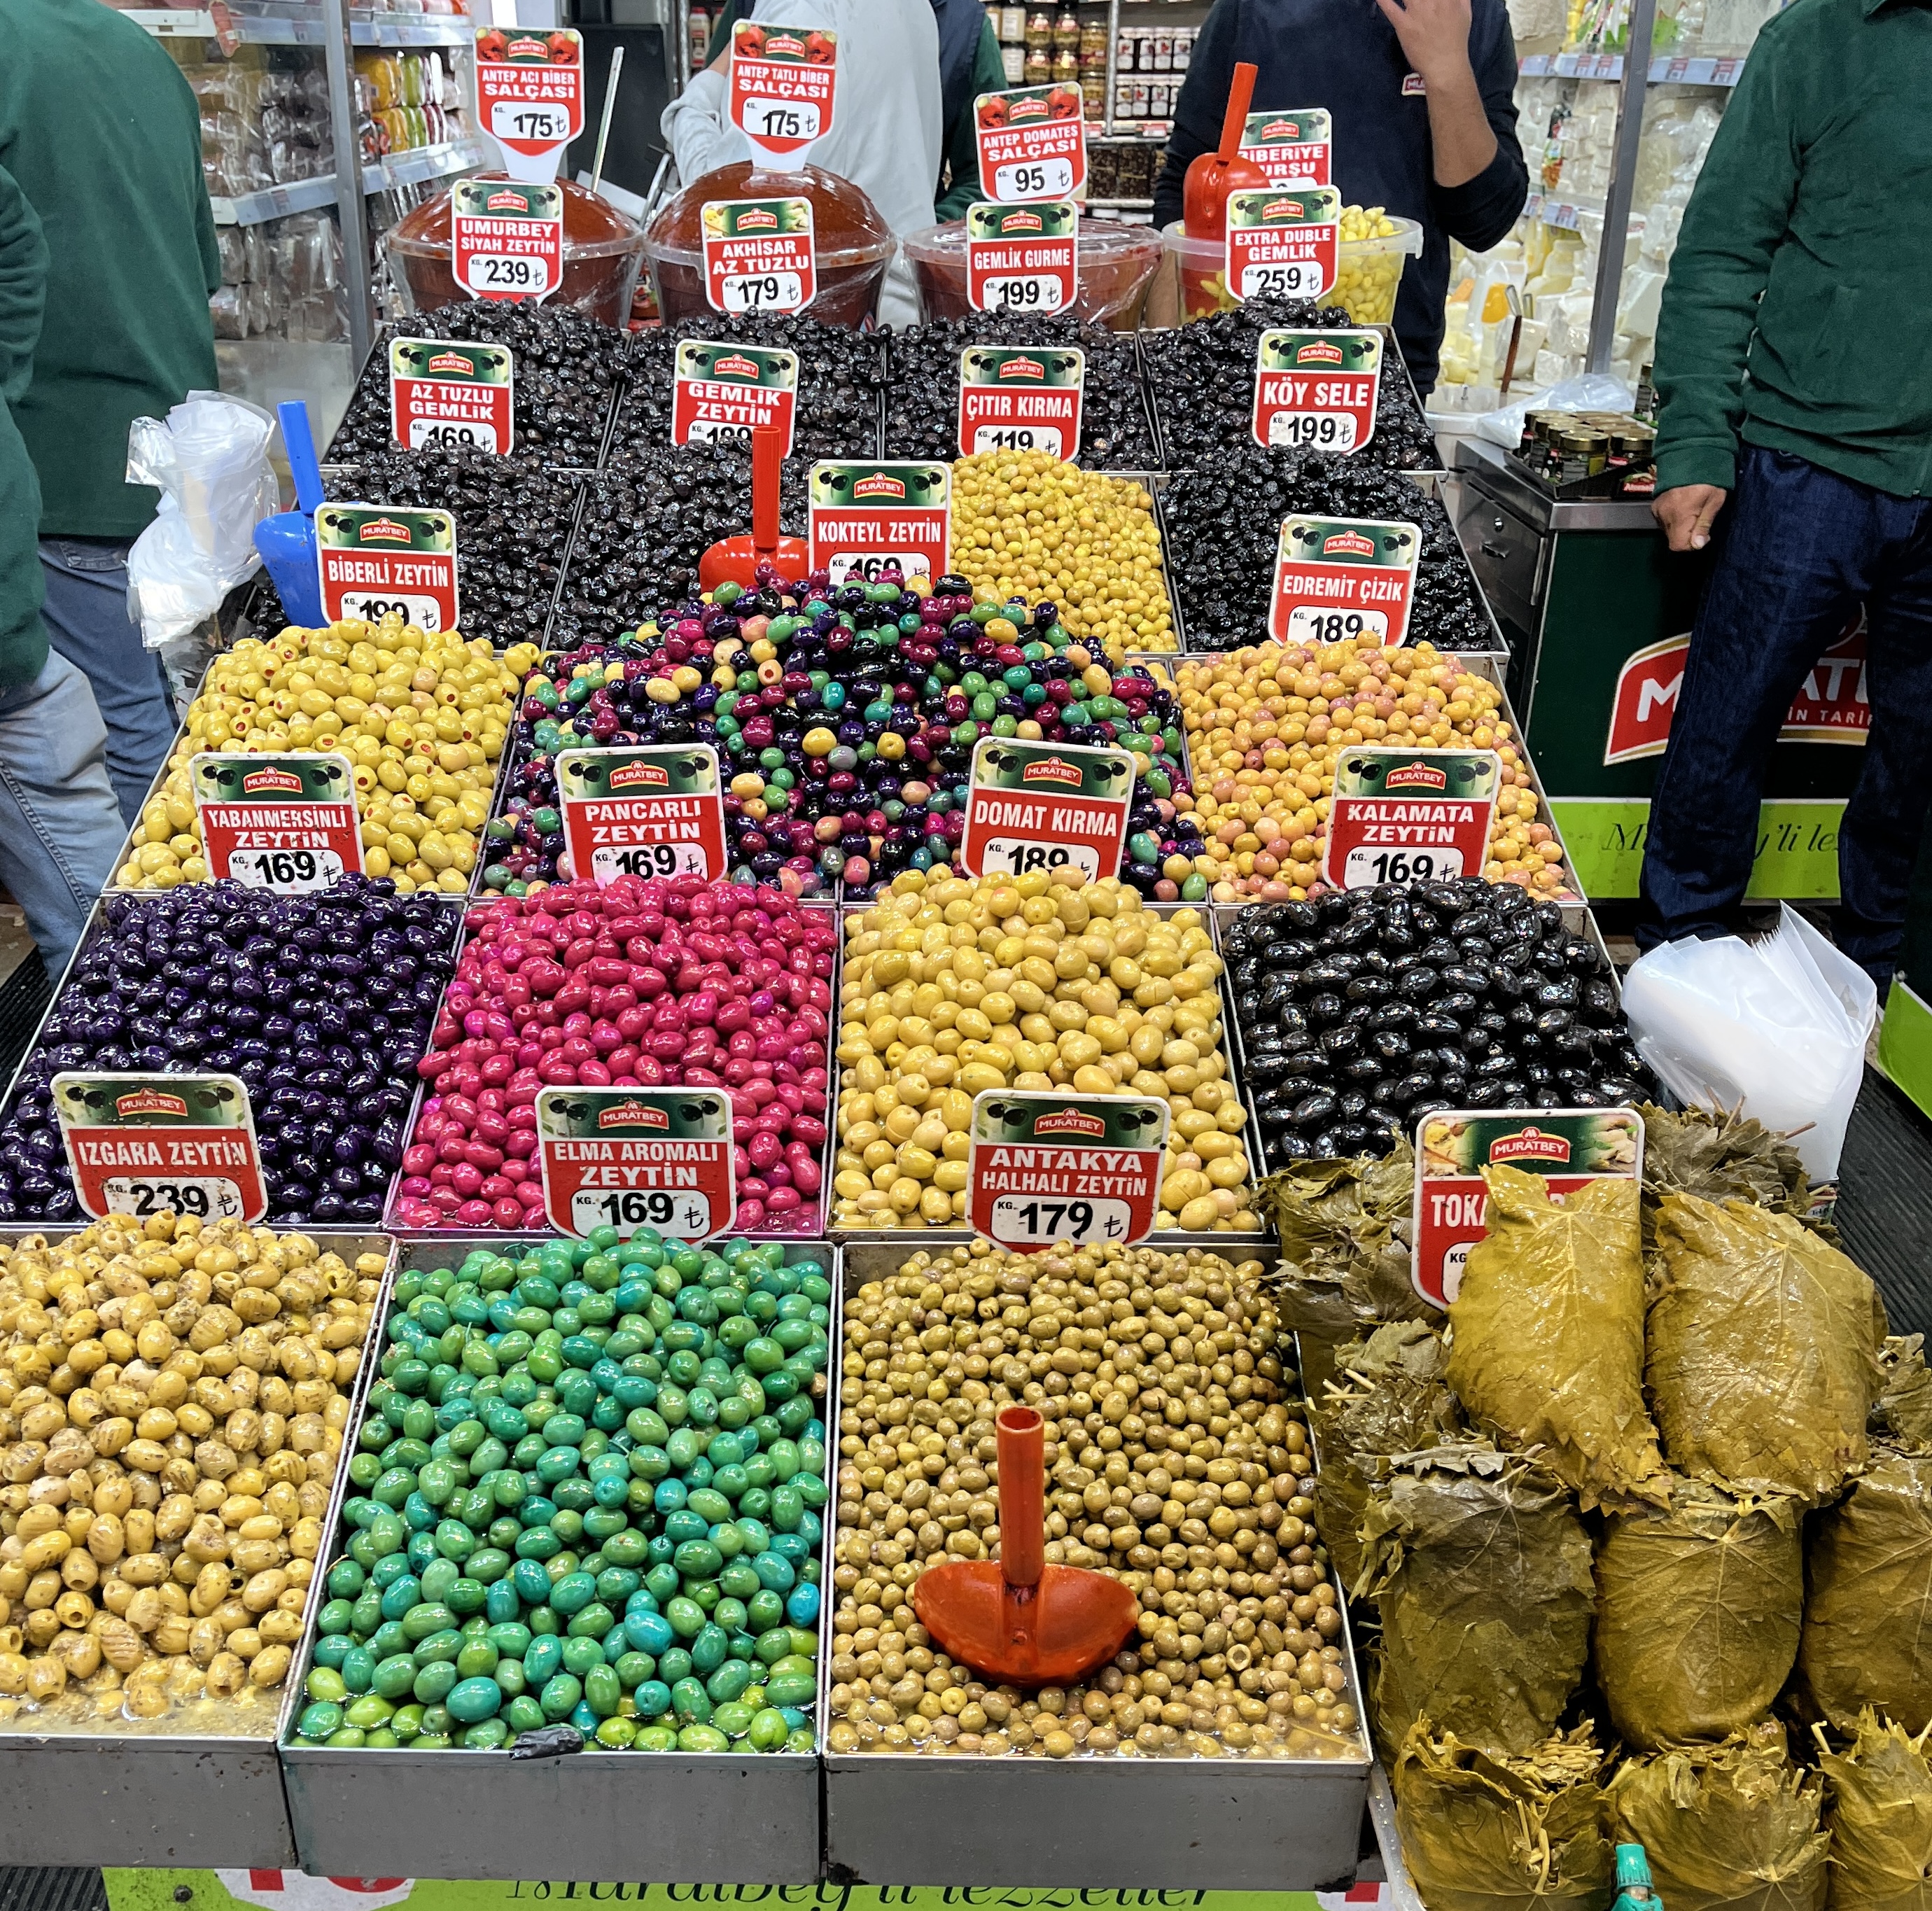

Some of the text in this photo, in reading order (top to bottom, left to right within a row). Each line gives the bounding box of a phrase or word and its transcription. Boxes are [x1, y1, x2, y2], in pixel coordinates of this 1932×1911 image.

[482, 69, 575, 85] ANTEP ACI BİBER
[737, 65, 830, 85] ANTEP TATLI BİBER
[485, 83, 574, 100] SALÇASI
[739, 79, 827, 99] SALÇASI
[514, 113, 553, 139] 175
[762, 110, 799, 136] 175
[983, 133, 1020, 149] ANTEP
[1023, 125, 1078, 143] DOMATES
[988, 139, 1077, 162] SALÇASI
[1015, 167, 1045, 192] 95
[461, 220, 553, 237] UMURBEY
[1236, 228, 1331, 246] EXTRA DUBLE
[461, 234, 555, 254] SİYAH ZEYTİN
[722, 239, 796, 258] AKHİSAR
[713, 255, 808, 274] AZ TUZLU
[974, 247, 1070, 270] GEMLİK GURME
[484, 260, 529, 284] 239
[1256, 267, 1301, 292] 259
[738, 276, 778, 304] 179
[998, 281, 1040, 307] 199
[1301, 349, 1339, 358] MURATBEY
[718, 363, 755, 373] MURATBEY
[411, 384, 494, 404] AZ TUZLU
[1264, 377, 1369, 407] KÖY SELE
[696, 402, 771, 424] ZEYTİN
[967, 395, 1072, 421] ÇITIR KIRMA
[1288, 416, 1336, 443] 199
[991, 430, 1033, 452] 119
[858, 482, 902, 492] MURATBEY
[363, 528, 407, 537] MURATBEY
[818, 517, 941, 542] KOKTEYL ZEYTİN
[1328, 540, 1371, 550] MURATBEY
[328, 555, 448, 587] BİBERLİ ZEYTİN
[1283, 574, 1404, 604] EDREMİT ÇİZİK
[1310, 614, 1363, 643] 189
[247, 777, 298, 787] MURATBEY
[613, 771, 664, 782] MURATBEY
[1028, 767, 1079, 778] MURATBEY
[1391, 773, 1442, 783] MURATBEY
[207, 806, 346, 828] YABANMERSİNLİ
[584, 800, 701, 822] PANCARLI
[974, 800, 1117, 837] DOMAT KIRMA
[1348, 804, 1474, 822] KALAMATA
[592, 820, 701, 843] ZEYTİN
[989, 844, 1004, 852] KG.
[255, 850, 316, 884] 169
[616, 844, 676, 880] 169
[1373, 853, 1434, 883] 169
[121, 1099, 181, 1110] MURATBEY
[603, 1112, 664, 1122] MURATBEY
[1039, 1120, 1100, 1130] MURATBEY
[77, 1137, 247, 1166] IZGARA ZEYTİN
[554, 1142, 718, 1161] ELMA AROMALI
[1494, 1141, 1565, 1155] MURATBEY
[989, 1148, 1142, 1172] ANTAKYA
[580, 1162, 698, 1186] ZEYTİN
[982, 1172, 1069, 1193] HALHALI
[130, 1185, 209, 1217] 239
[601, 1193, 673, 1225] 169
[997, 1201, 1018, 1210] KG.
[1019, 1201, 1093, 1239] 179
